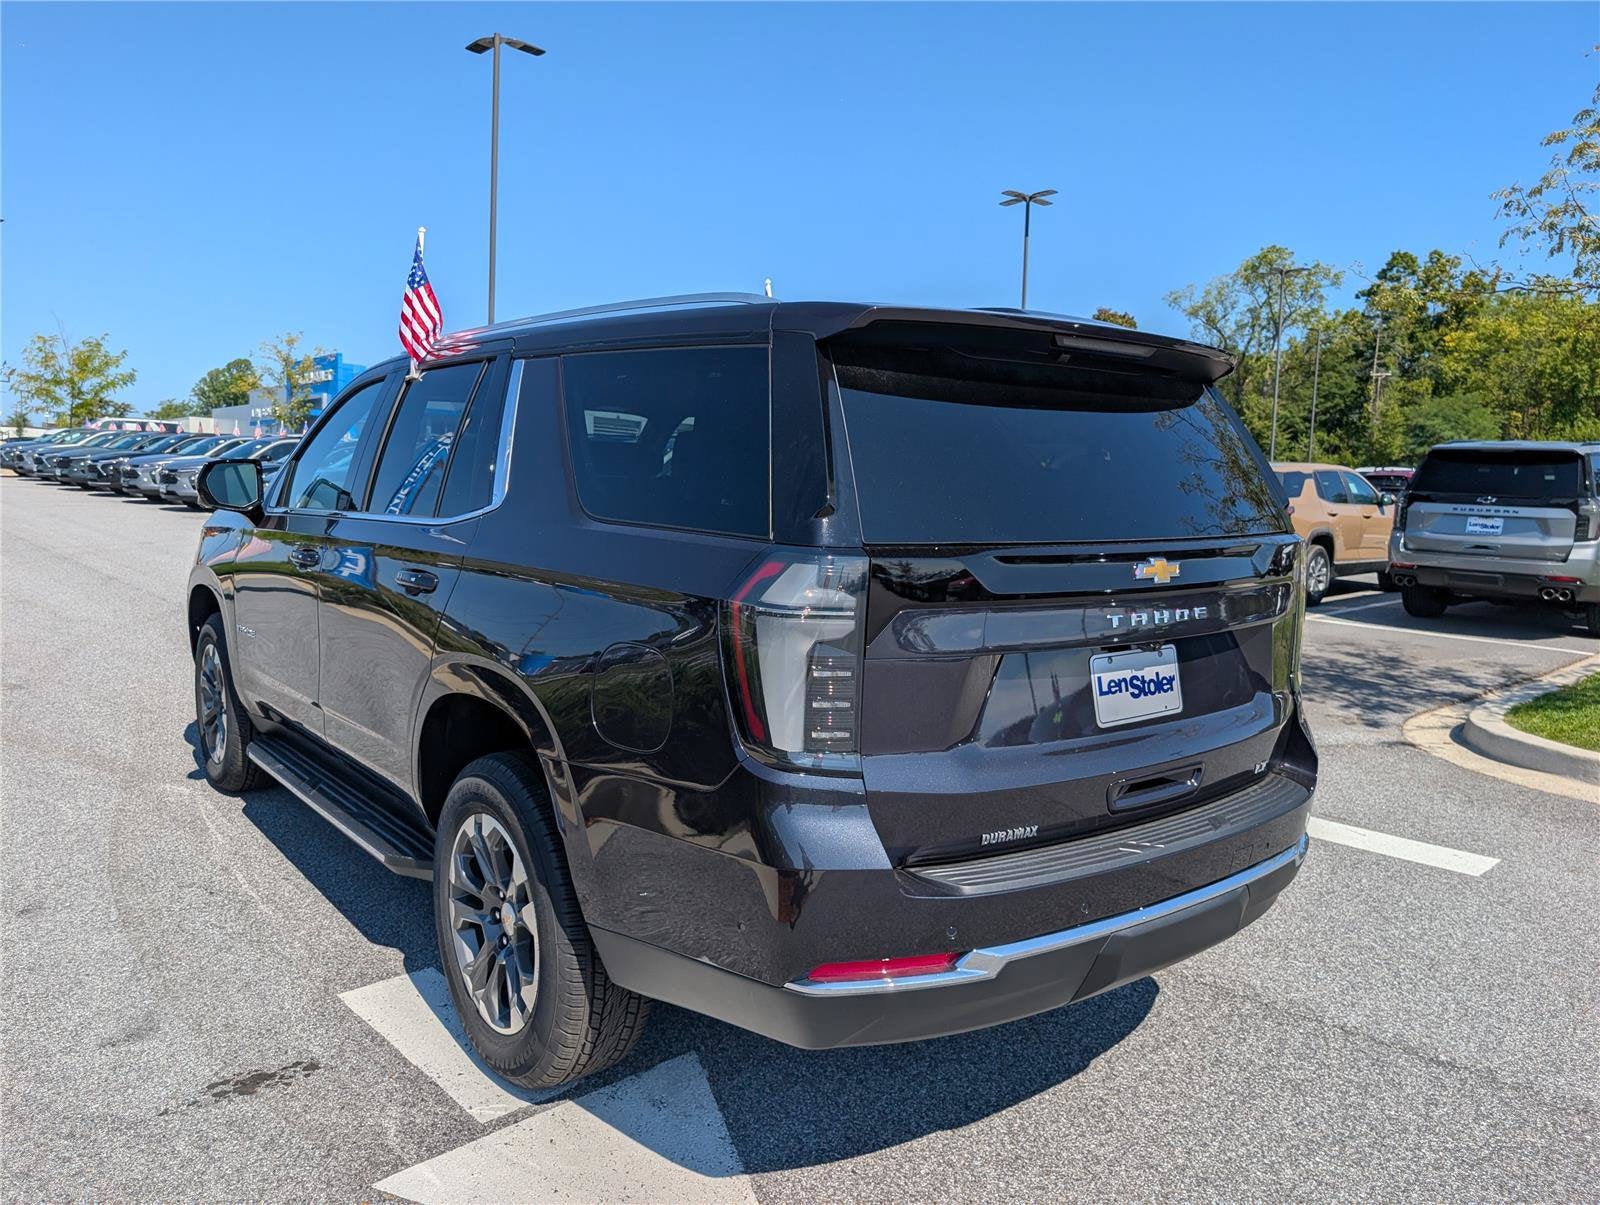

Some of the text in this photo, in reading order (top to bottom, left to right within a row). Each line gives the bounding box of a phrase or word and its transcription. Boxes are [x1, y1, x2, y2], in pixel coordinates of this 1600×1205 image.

[1106, 606, 1208, 629] TAHOE
[1097, 671, 1176, 699] LenStoler
[1253, 760, 1269, 775] LT
[980, 824, 1039, 847] DURAMAX
